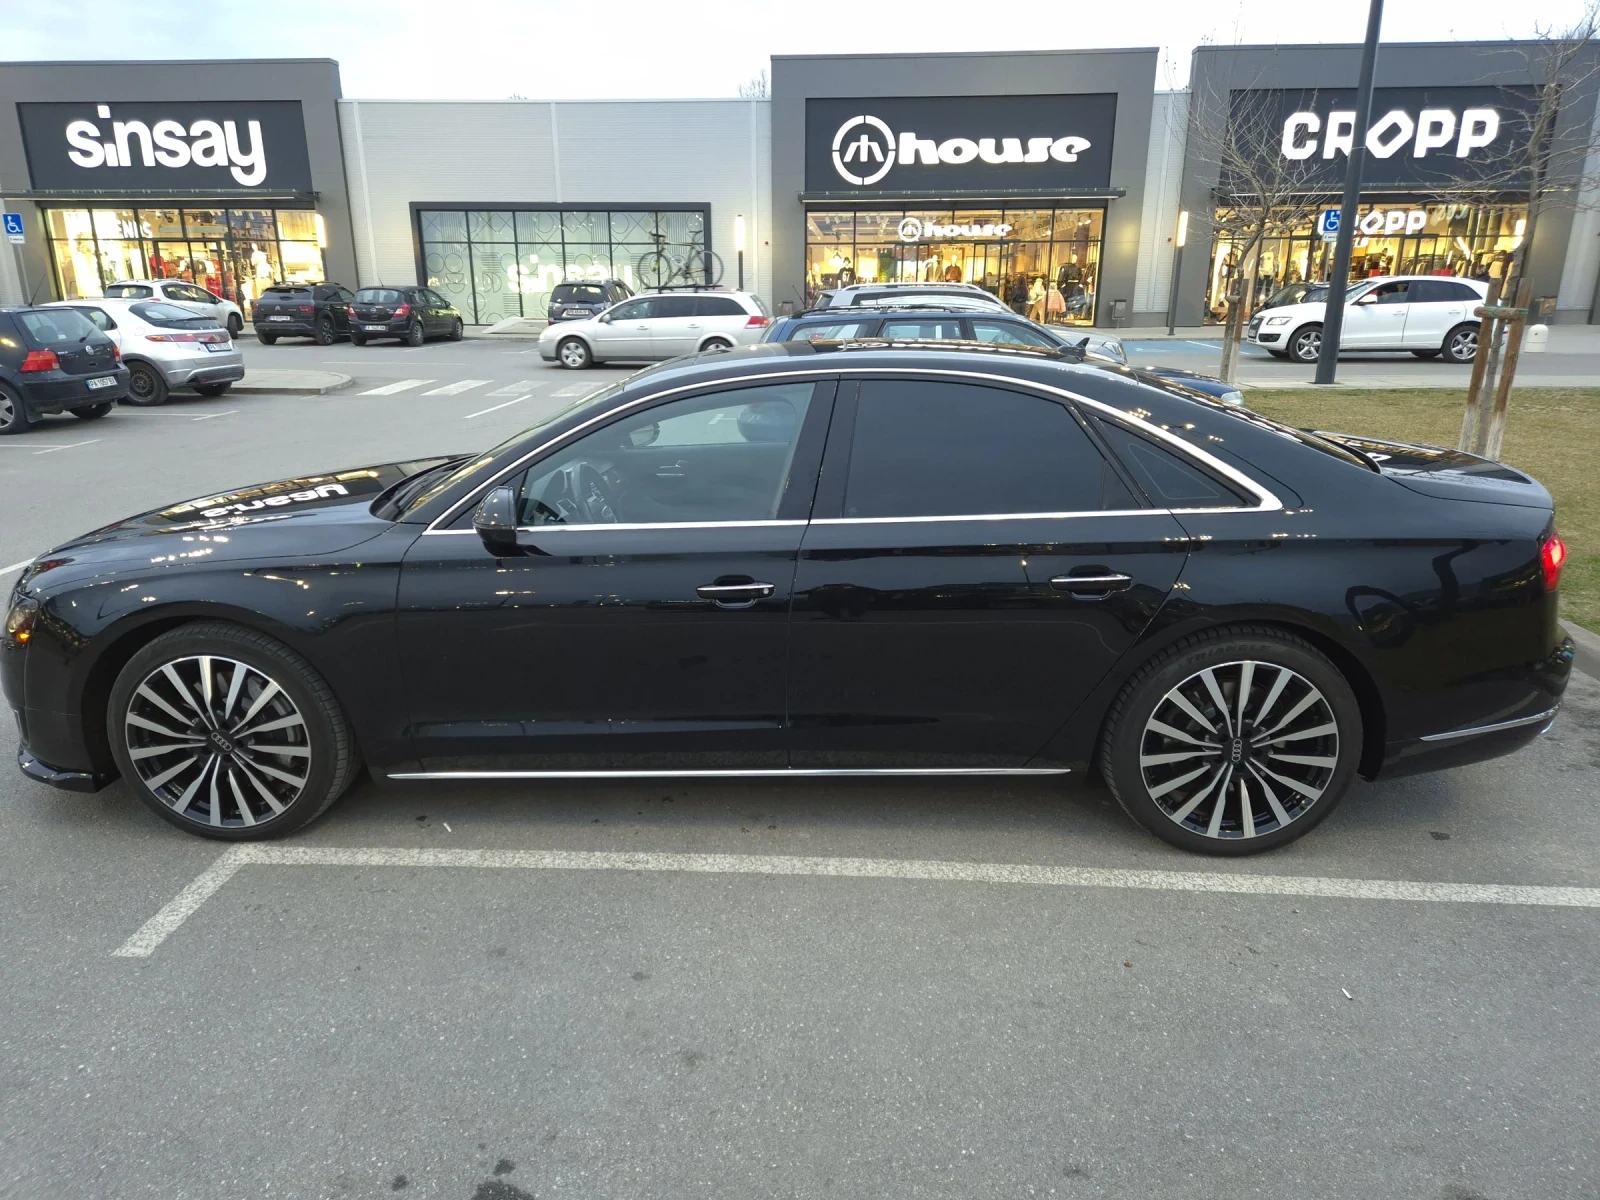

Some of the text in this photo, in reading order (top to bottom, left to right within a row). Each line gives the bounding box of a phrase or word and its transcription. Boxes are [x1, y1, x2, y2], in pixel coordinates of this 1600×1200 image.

[66, 104, 267, 187] sinsay
[898, 132, 1092, 165] house
[1280, 109, 1501, 161] CROPP
[924, 221, 1013, 237] house
[1317, 211, 1427, 235] OPP
[1185, 644, 1272, 664] TRIANGLE
